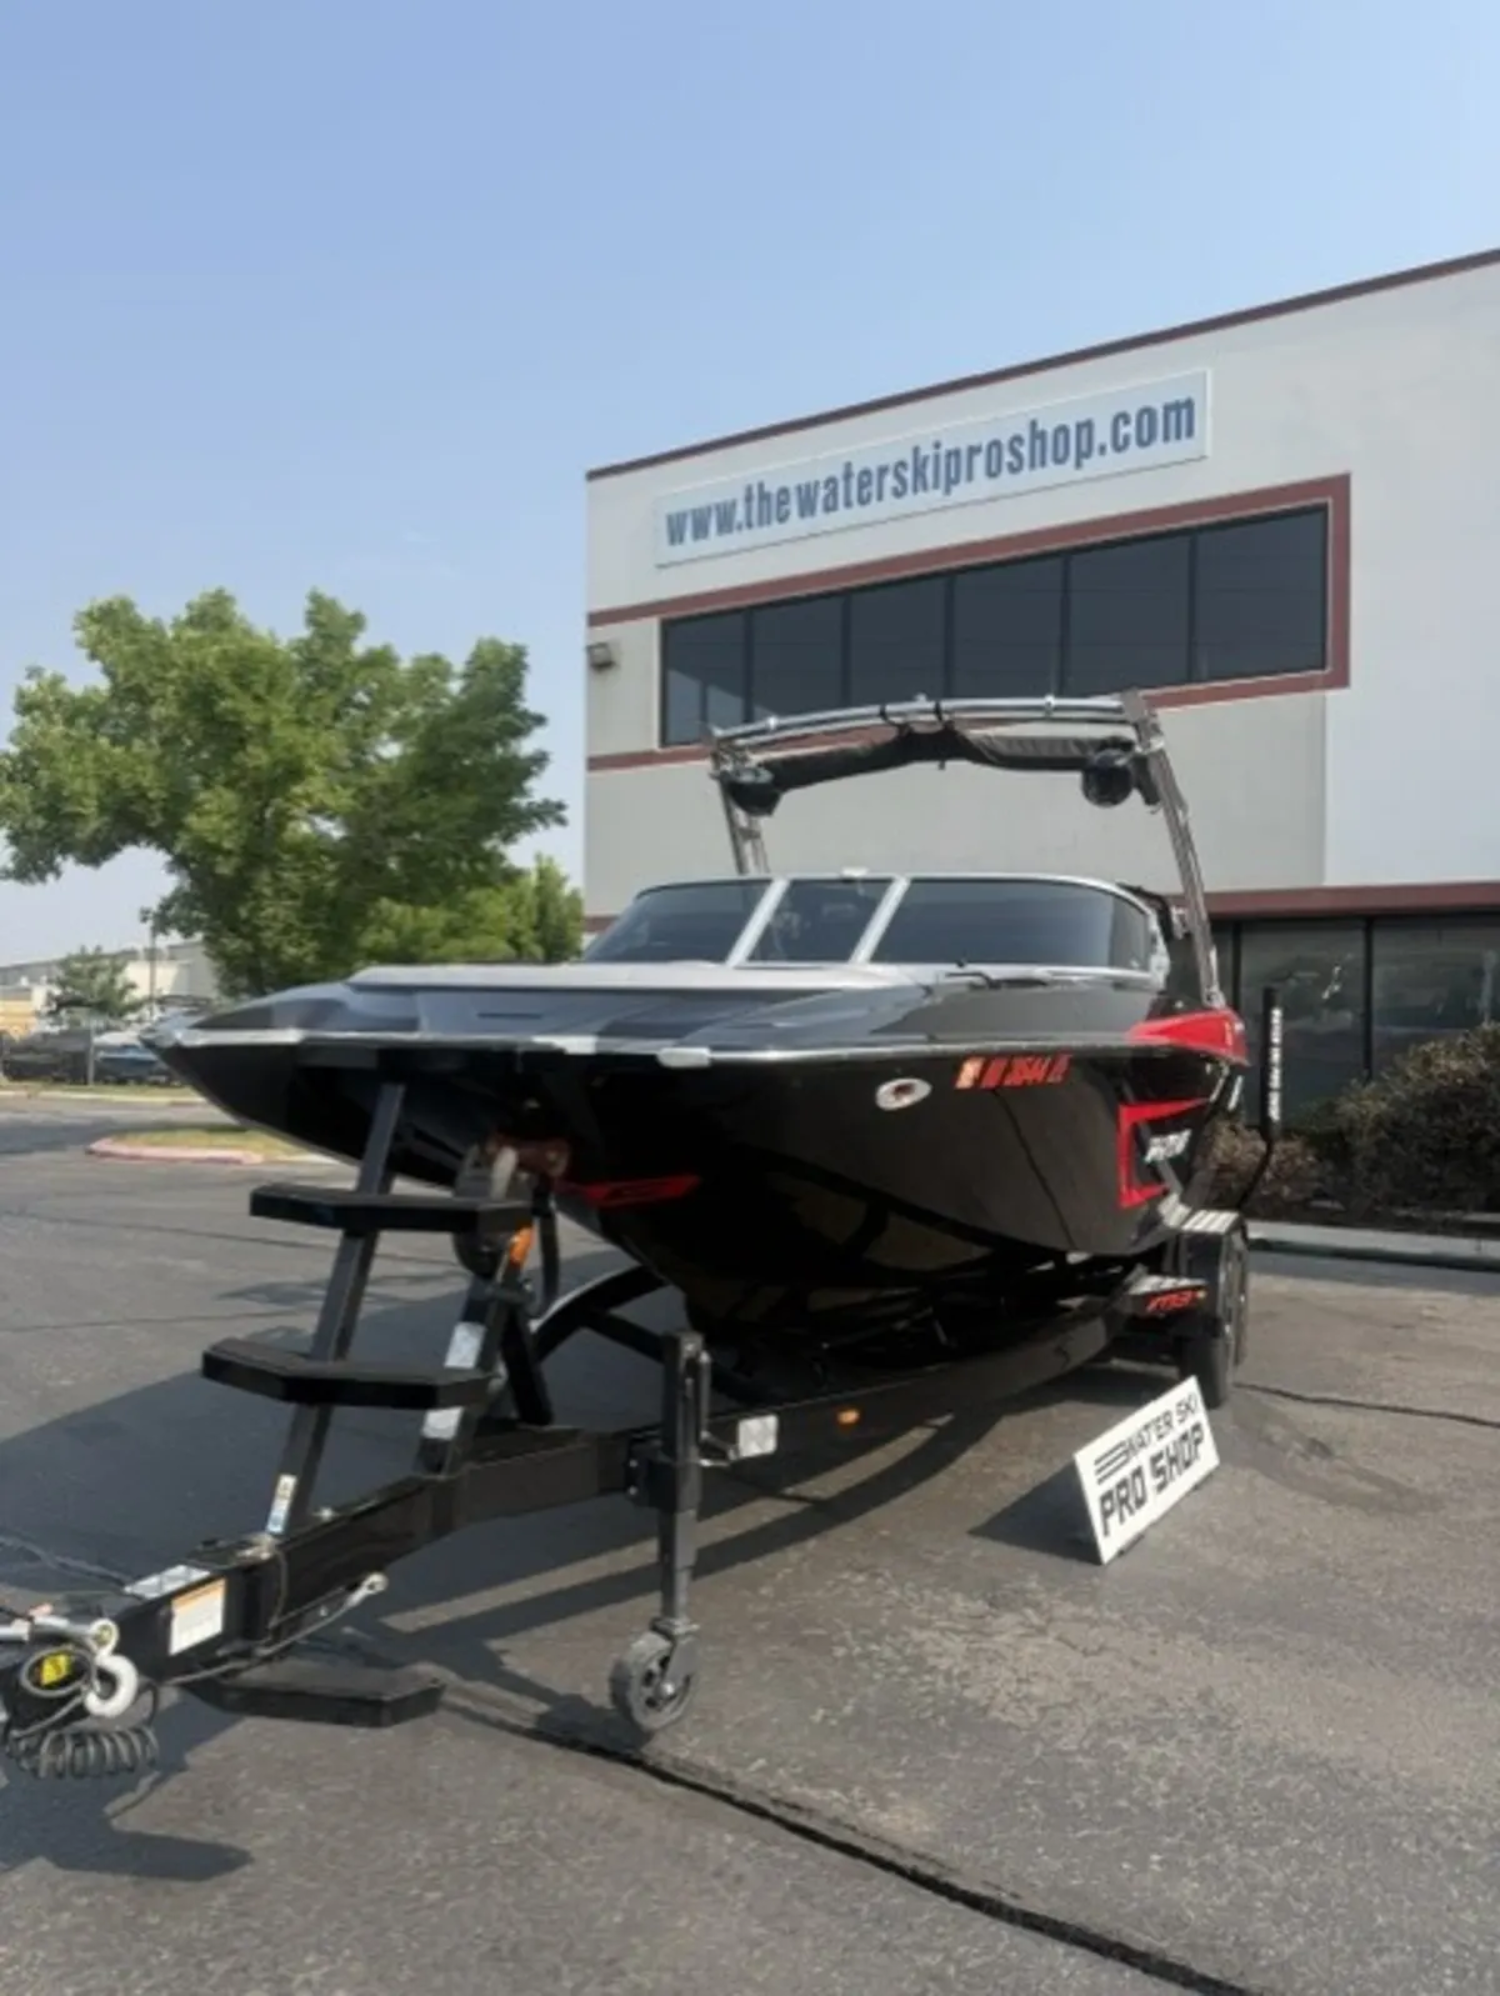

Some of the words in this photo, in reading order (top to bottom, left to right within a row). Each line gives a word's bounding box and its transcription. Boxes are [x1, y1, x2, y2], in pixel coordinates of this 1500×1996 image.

[666, 397, 1197, 546] www.thewaterskiproshop.com
[1099, 1465, 1148, 1537] PRO
[1150, 1422, 1205, 1495] SHOP
